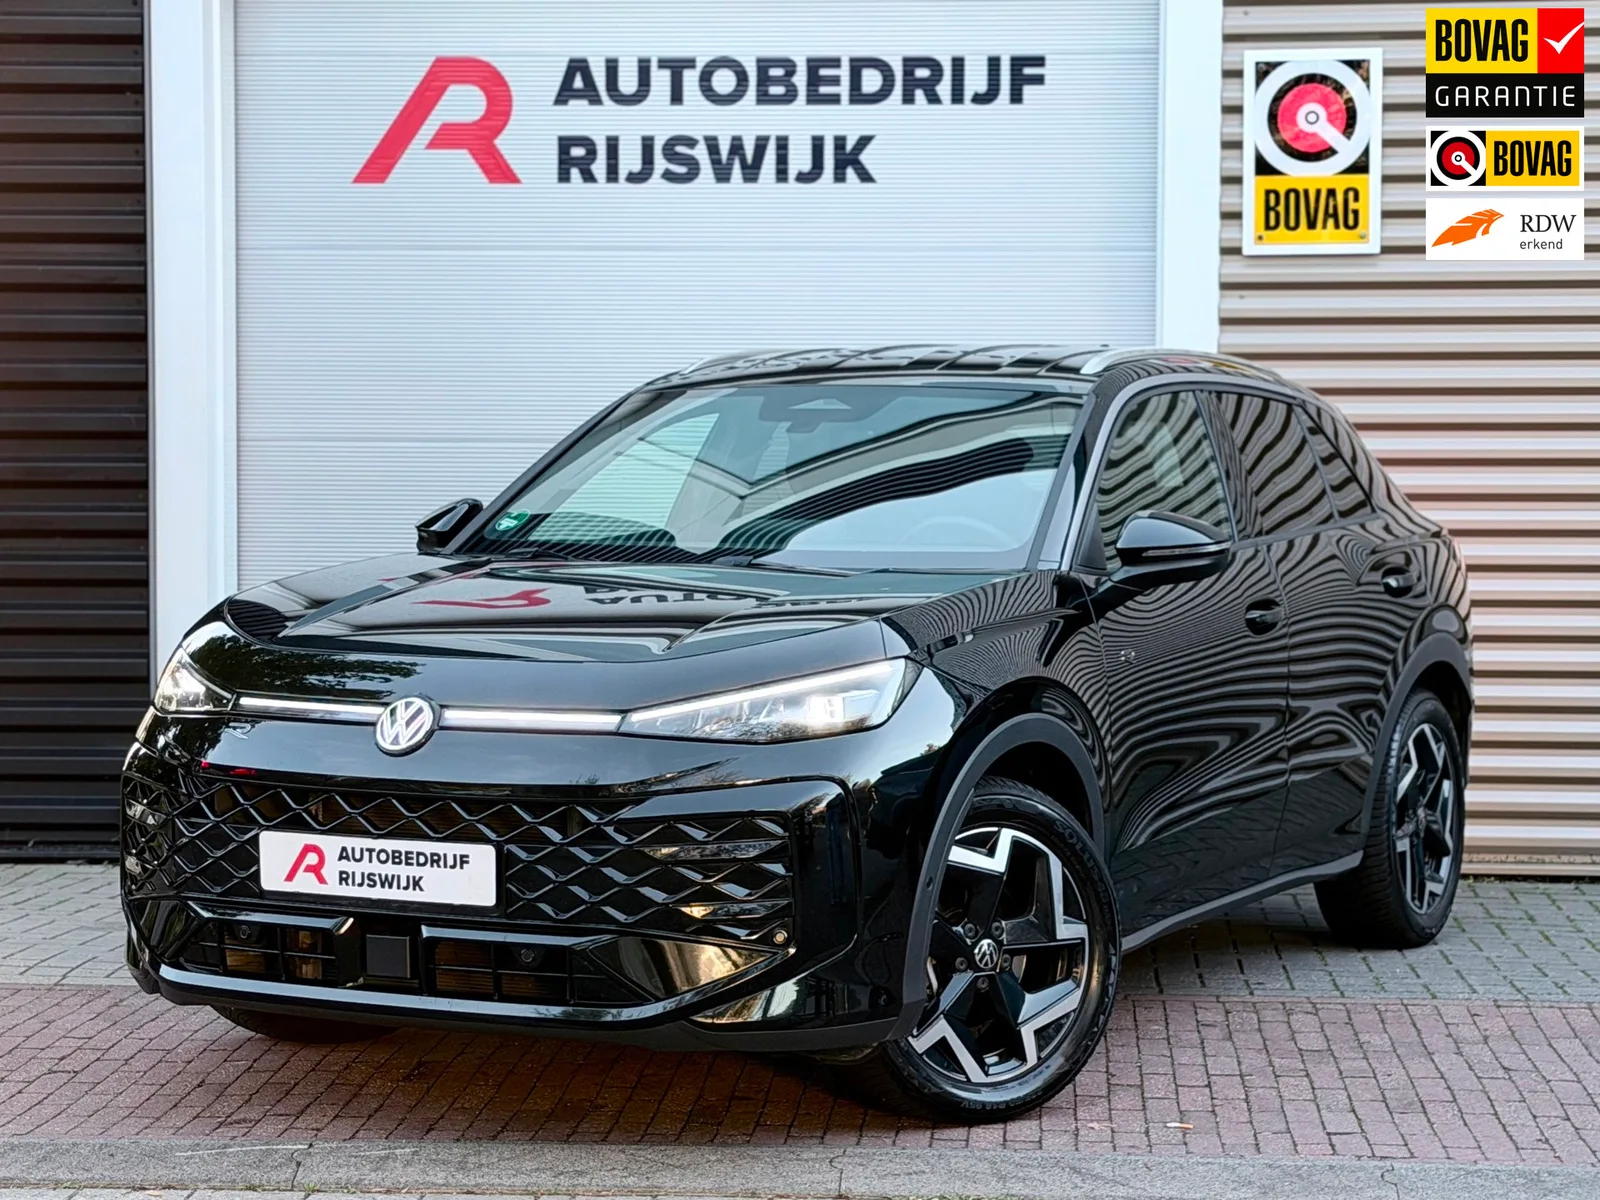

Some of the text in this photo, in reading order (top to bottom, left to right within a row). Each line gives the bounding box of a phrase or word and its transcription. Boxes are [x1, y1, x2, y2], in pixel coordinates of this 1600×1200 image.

[553, 55, 1047, 107] AUTOBEDRIJF
[557, 134, 877, 185] RIJSWIJK
[1264, 187, 1360, 232] BOVAG
[337, 845, 470, 870] AUTOBEDRIJF
[338, 870, 425, 892] RIJSWIJK
